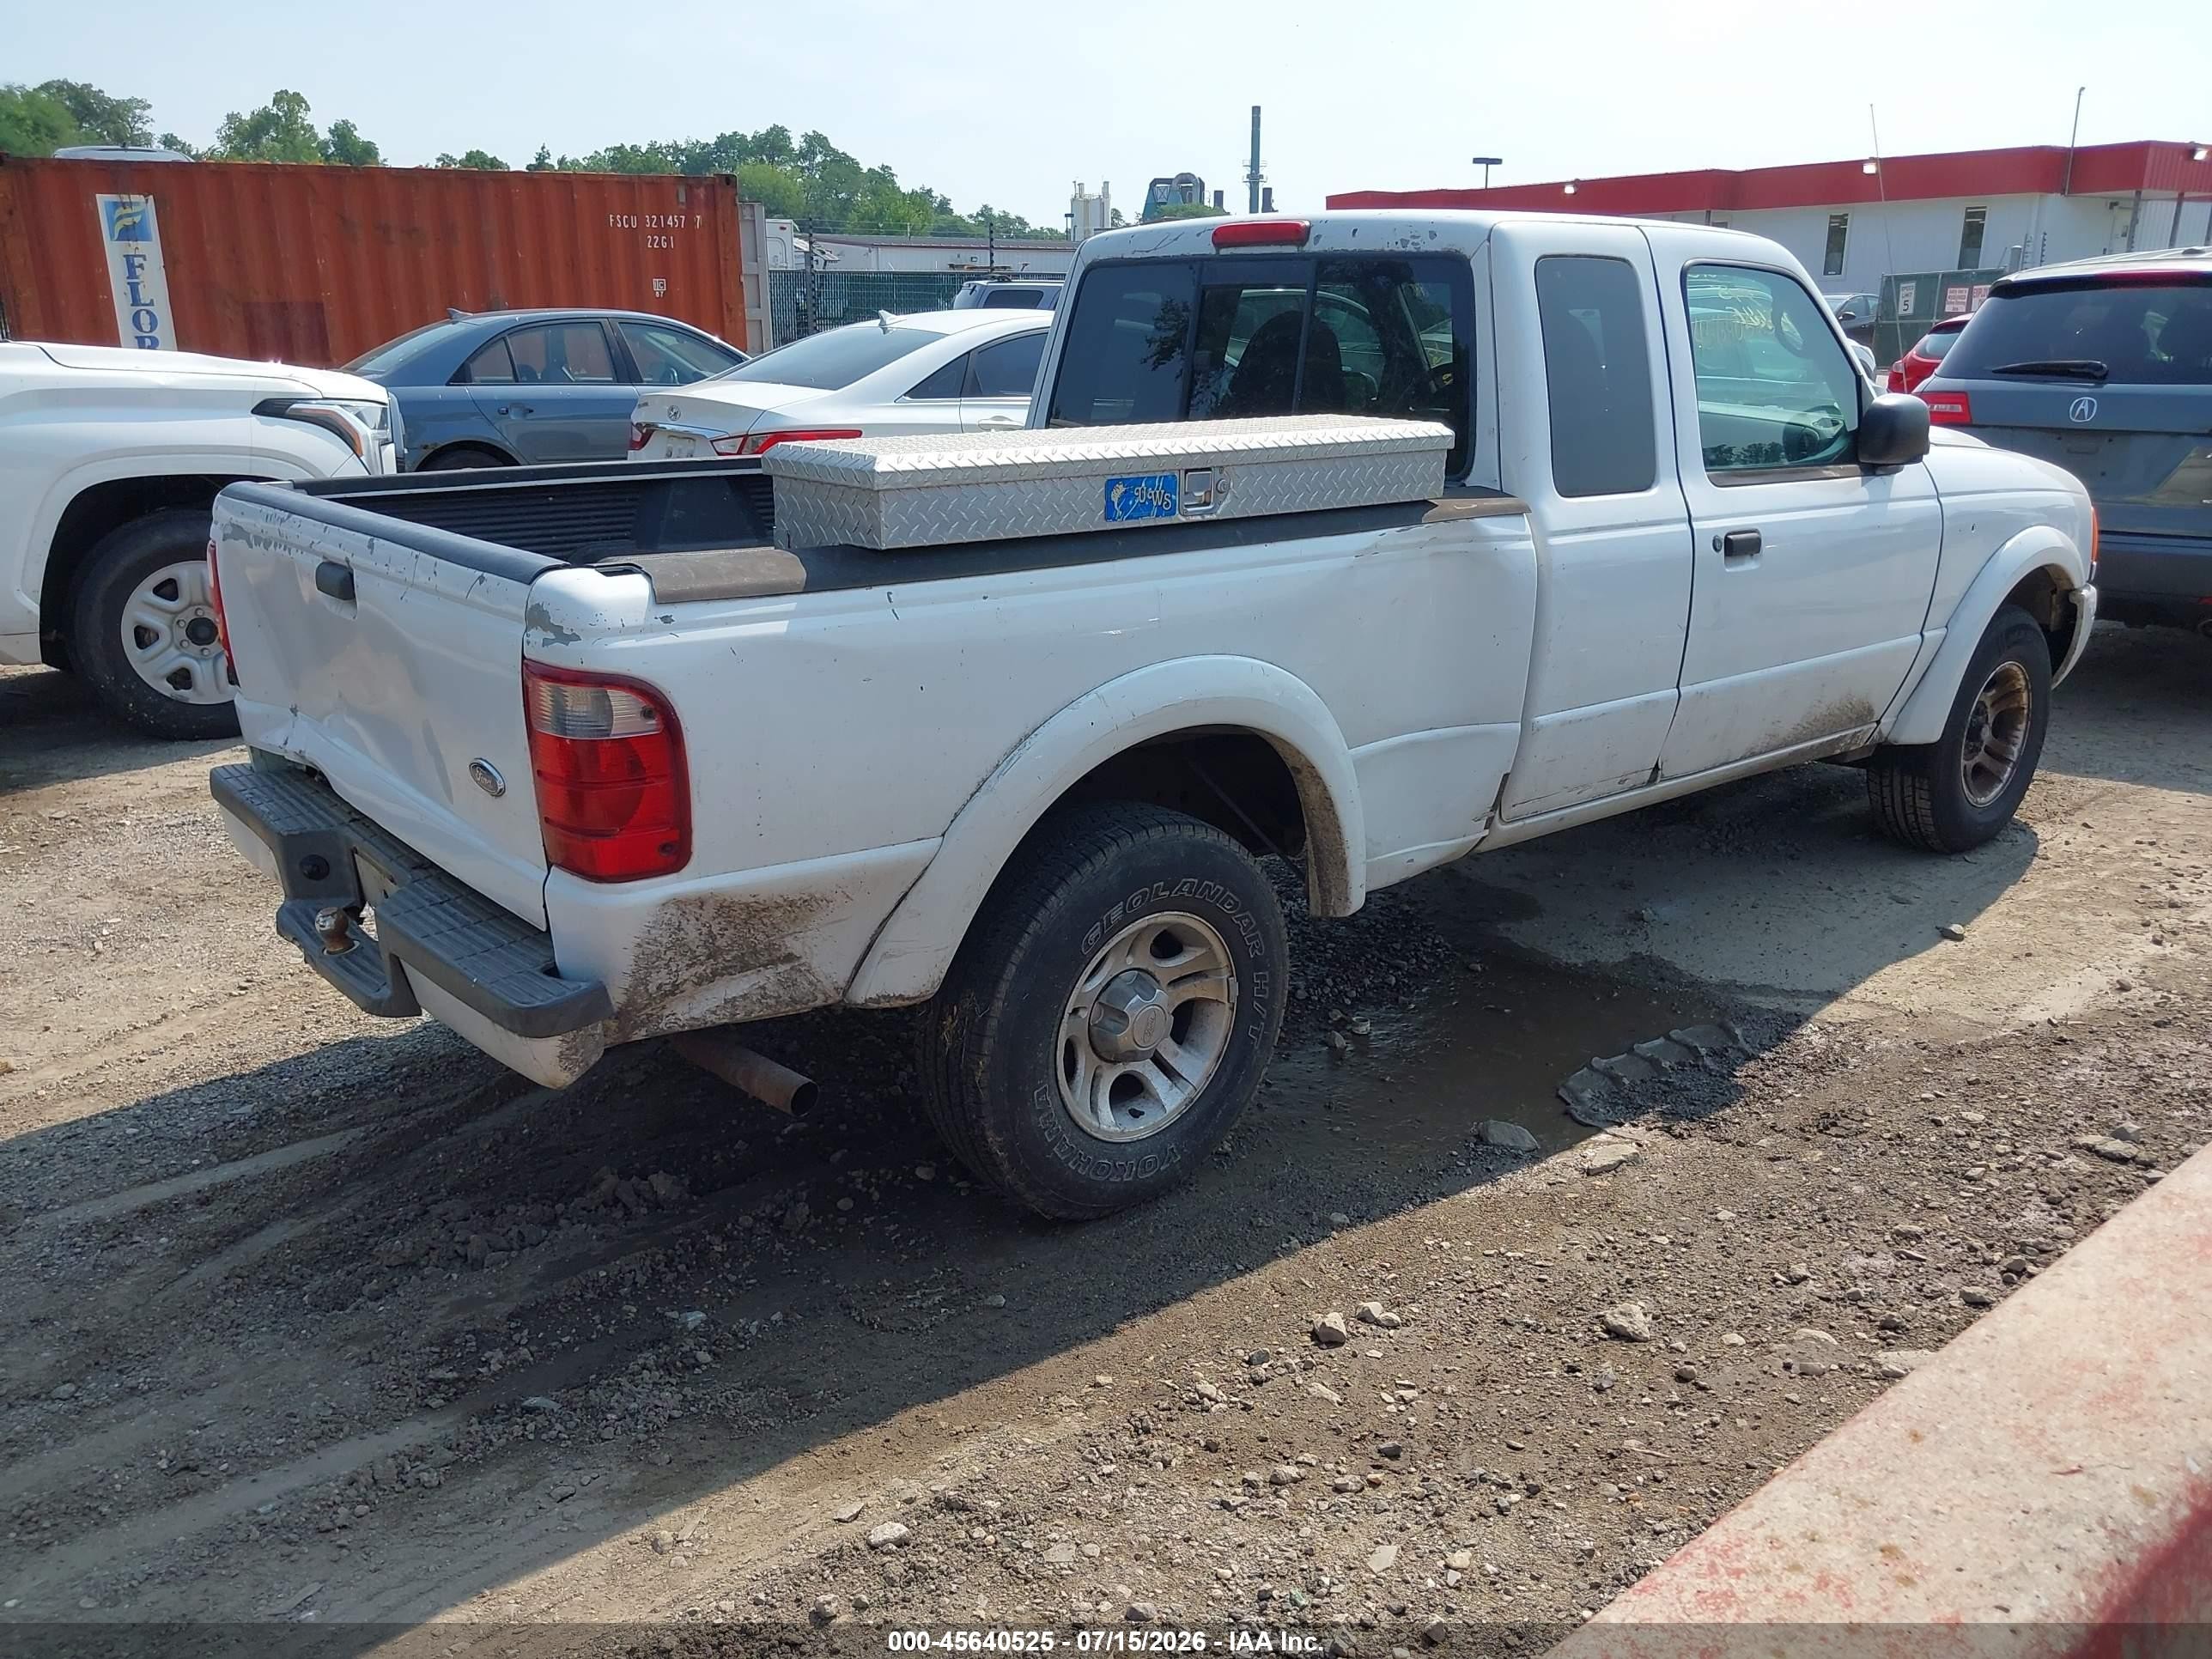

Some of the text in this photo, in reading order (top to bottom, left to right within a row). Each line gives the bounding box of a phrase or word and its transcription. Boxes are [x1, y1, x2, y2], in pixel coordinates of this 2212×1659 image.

[609, 214, 702, 229] FSCU 321457 7
[1902, 299, 1910, 312] 5
[1081, 878, 1269, 1049] GEOLANDAR H/T
[1034, 1084, 1182, 1182] YOKOHAMA
